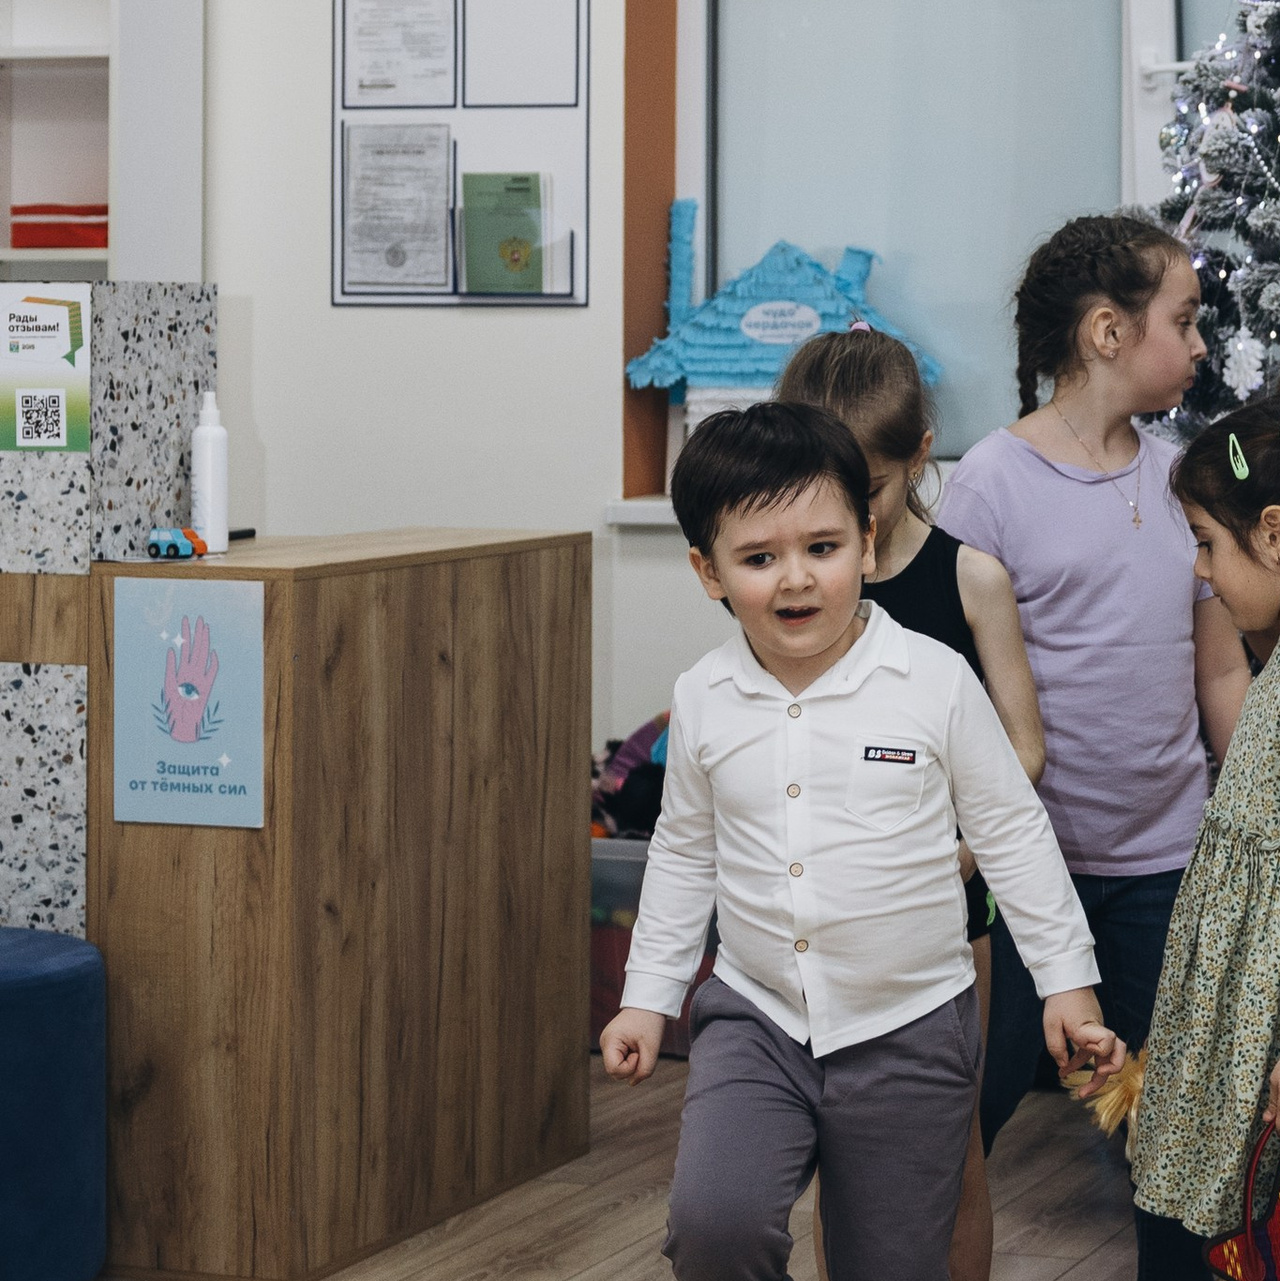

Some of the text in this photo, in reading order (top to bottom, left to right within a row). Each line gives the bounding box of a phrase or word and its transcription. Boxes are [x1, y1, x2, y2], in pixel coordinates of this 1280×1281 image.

[9, 313, 38, 323] Рады
[8, 322, 60, 332] отзывам!
[156, 761, 220, 777] Защита
[129, 777, 247, 796] от тёмных сил
